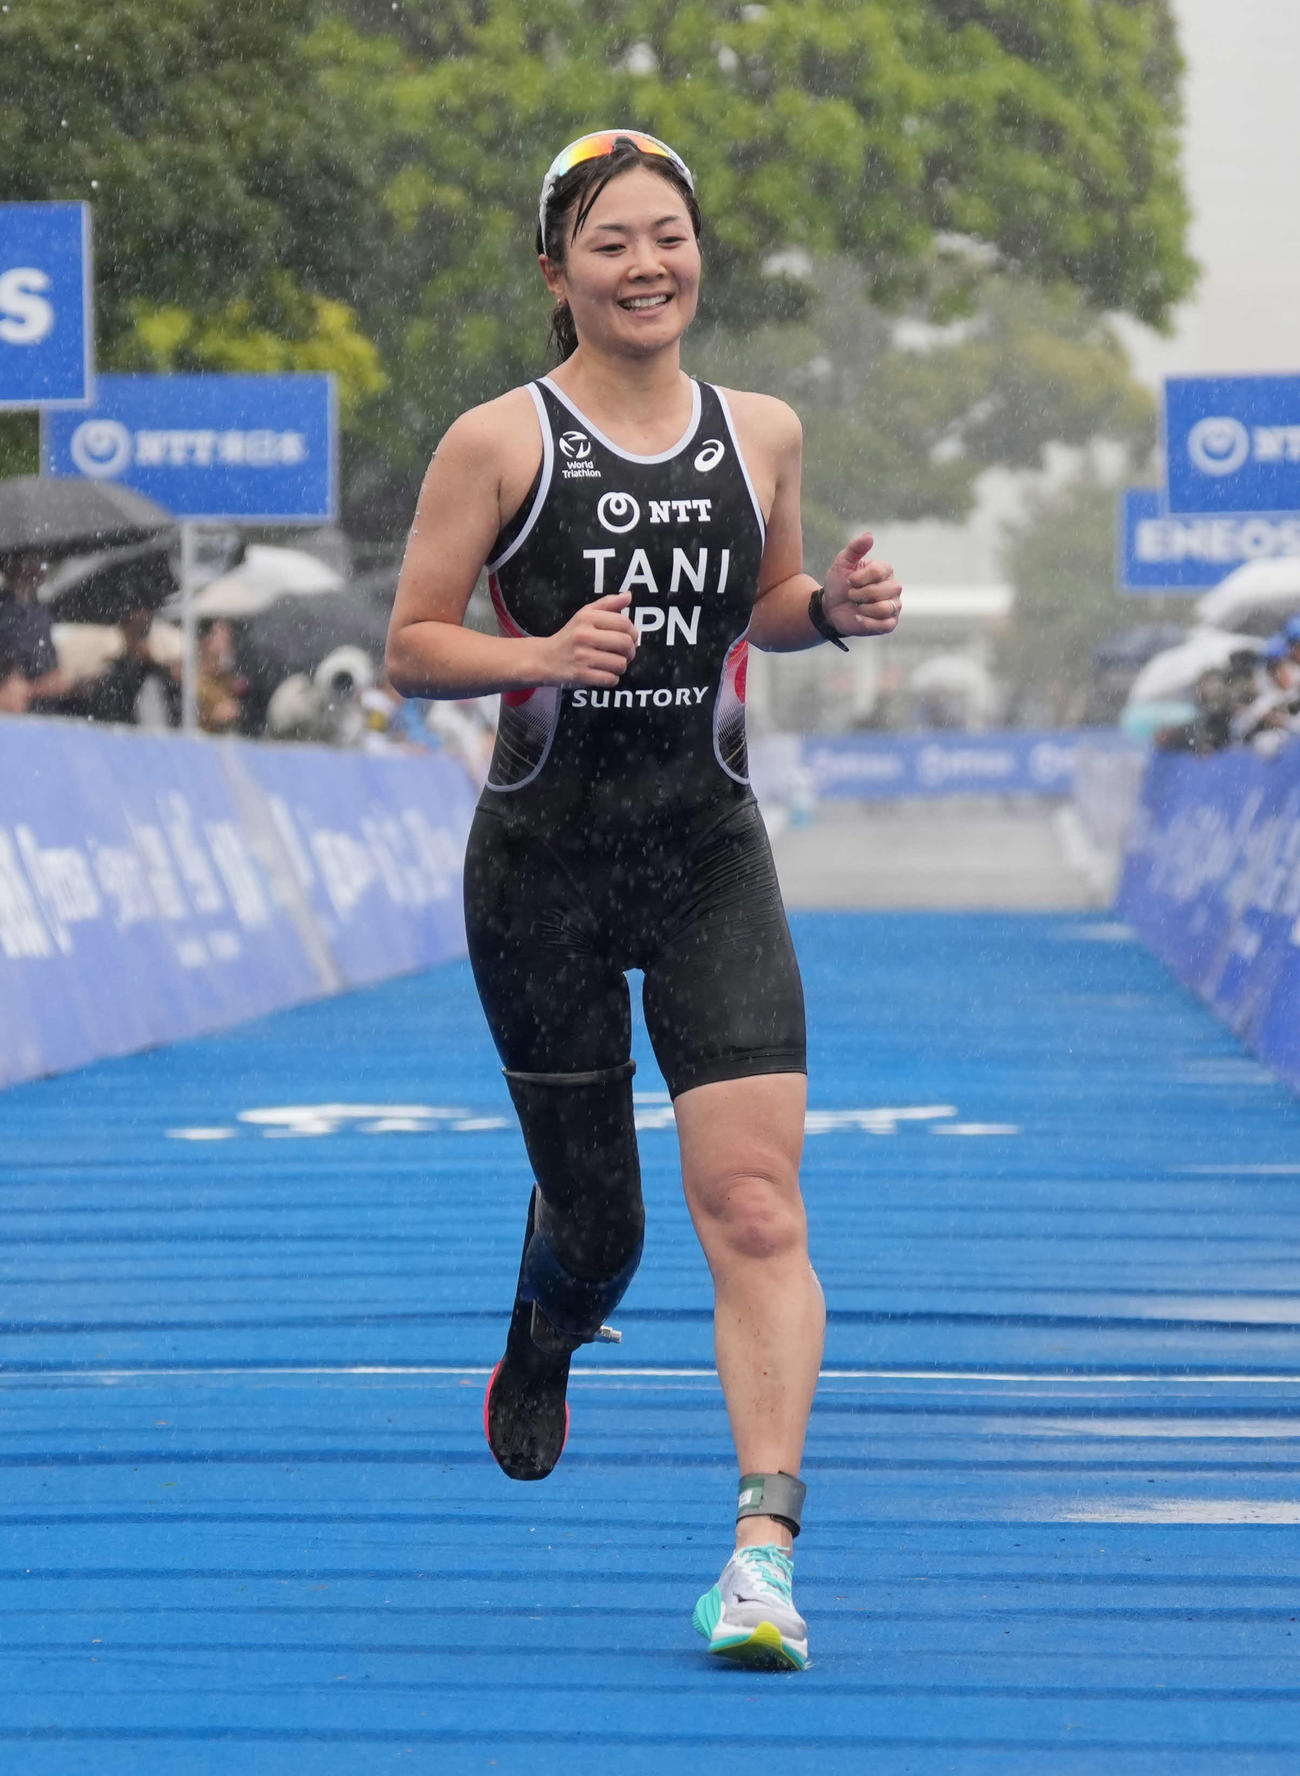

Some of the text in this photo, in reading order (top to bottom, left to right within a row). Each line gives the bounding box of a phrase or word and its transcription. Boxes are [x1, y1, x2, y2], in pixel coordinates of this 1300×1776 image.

[567, 460, 594, 470] World
[562, 469, 602, 479] Triathlon
[649, 499, 711, 524] NTT
[582, 548, 730, 594] TANI
